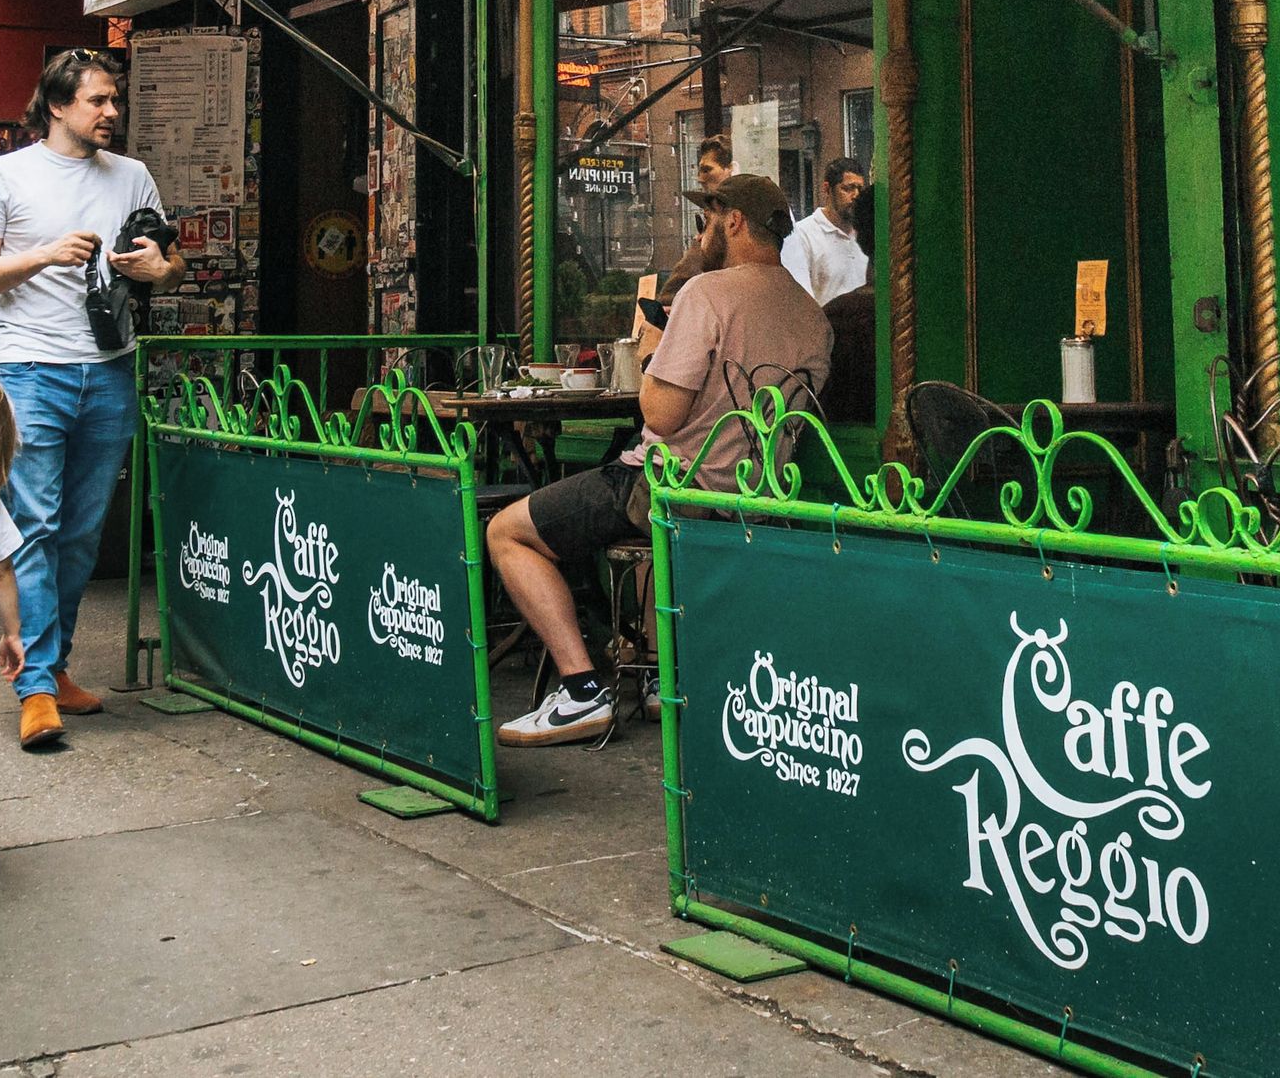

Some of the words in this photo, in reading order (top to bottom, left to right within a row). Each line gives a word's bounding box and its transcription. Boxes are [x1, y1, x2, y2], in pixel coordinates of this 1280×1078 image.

[180, 541, 230, 591] Cappuccino
[189, 520, 228, 563] Original
[274, 487, 340, 609] Caffe
[368, 586, 444, 649] Cappuccino
[382, 562, 441, 615] Original
[242, 560, 341, 688] Reggio
[398, 635, 423, 661] Since
[424, 645, 443, 666] 1927
[750, 650, 859, 727] Original
[722, 681, 863, 770] Cappuccino
[1002, 611, 1212, 840] Caffe
[776, 752, 820, 786] Since
[826, 767, 860, 797] 1927
[902, 728, 1210, 970] Reggio
